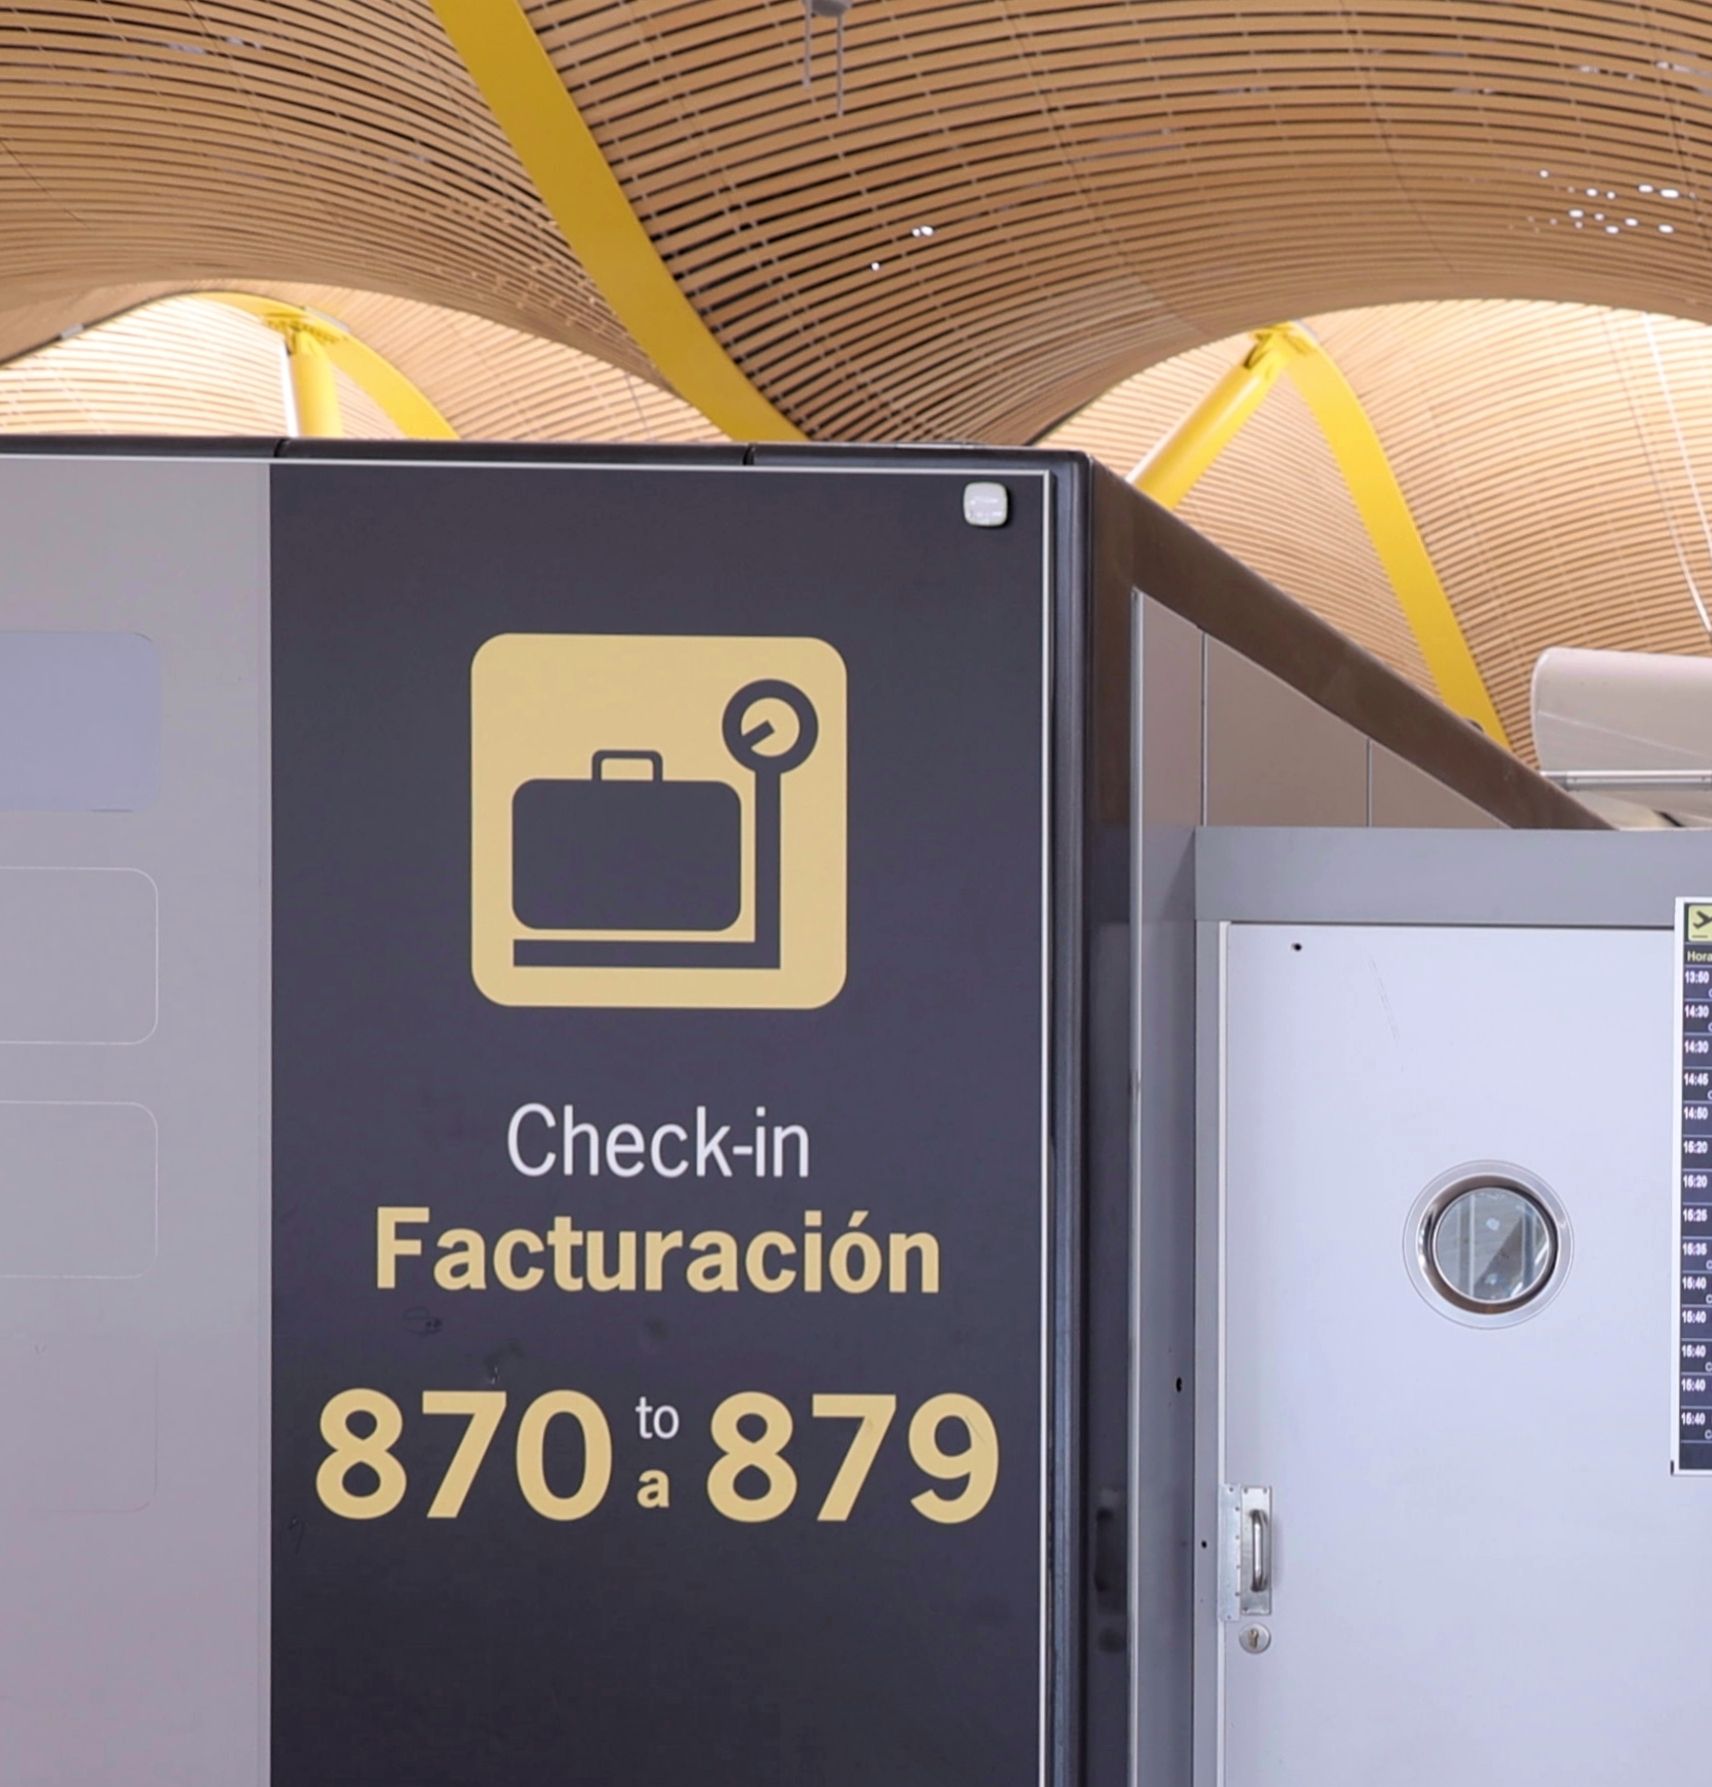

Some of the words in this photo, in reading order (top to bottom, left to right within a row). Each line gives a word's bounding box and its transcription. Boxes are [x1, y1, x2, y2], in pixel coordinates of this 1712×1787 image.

[506, 1102, 809, 1178] Check-in
[376, 1206, 939, 1293] Facturación
[315, 1388, 613, 1521] 870
[635, 1397, 680, 1439] to
[707, 1391, 1000, 1524] 879
[637, 1468, 670, 1508] a
